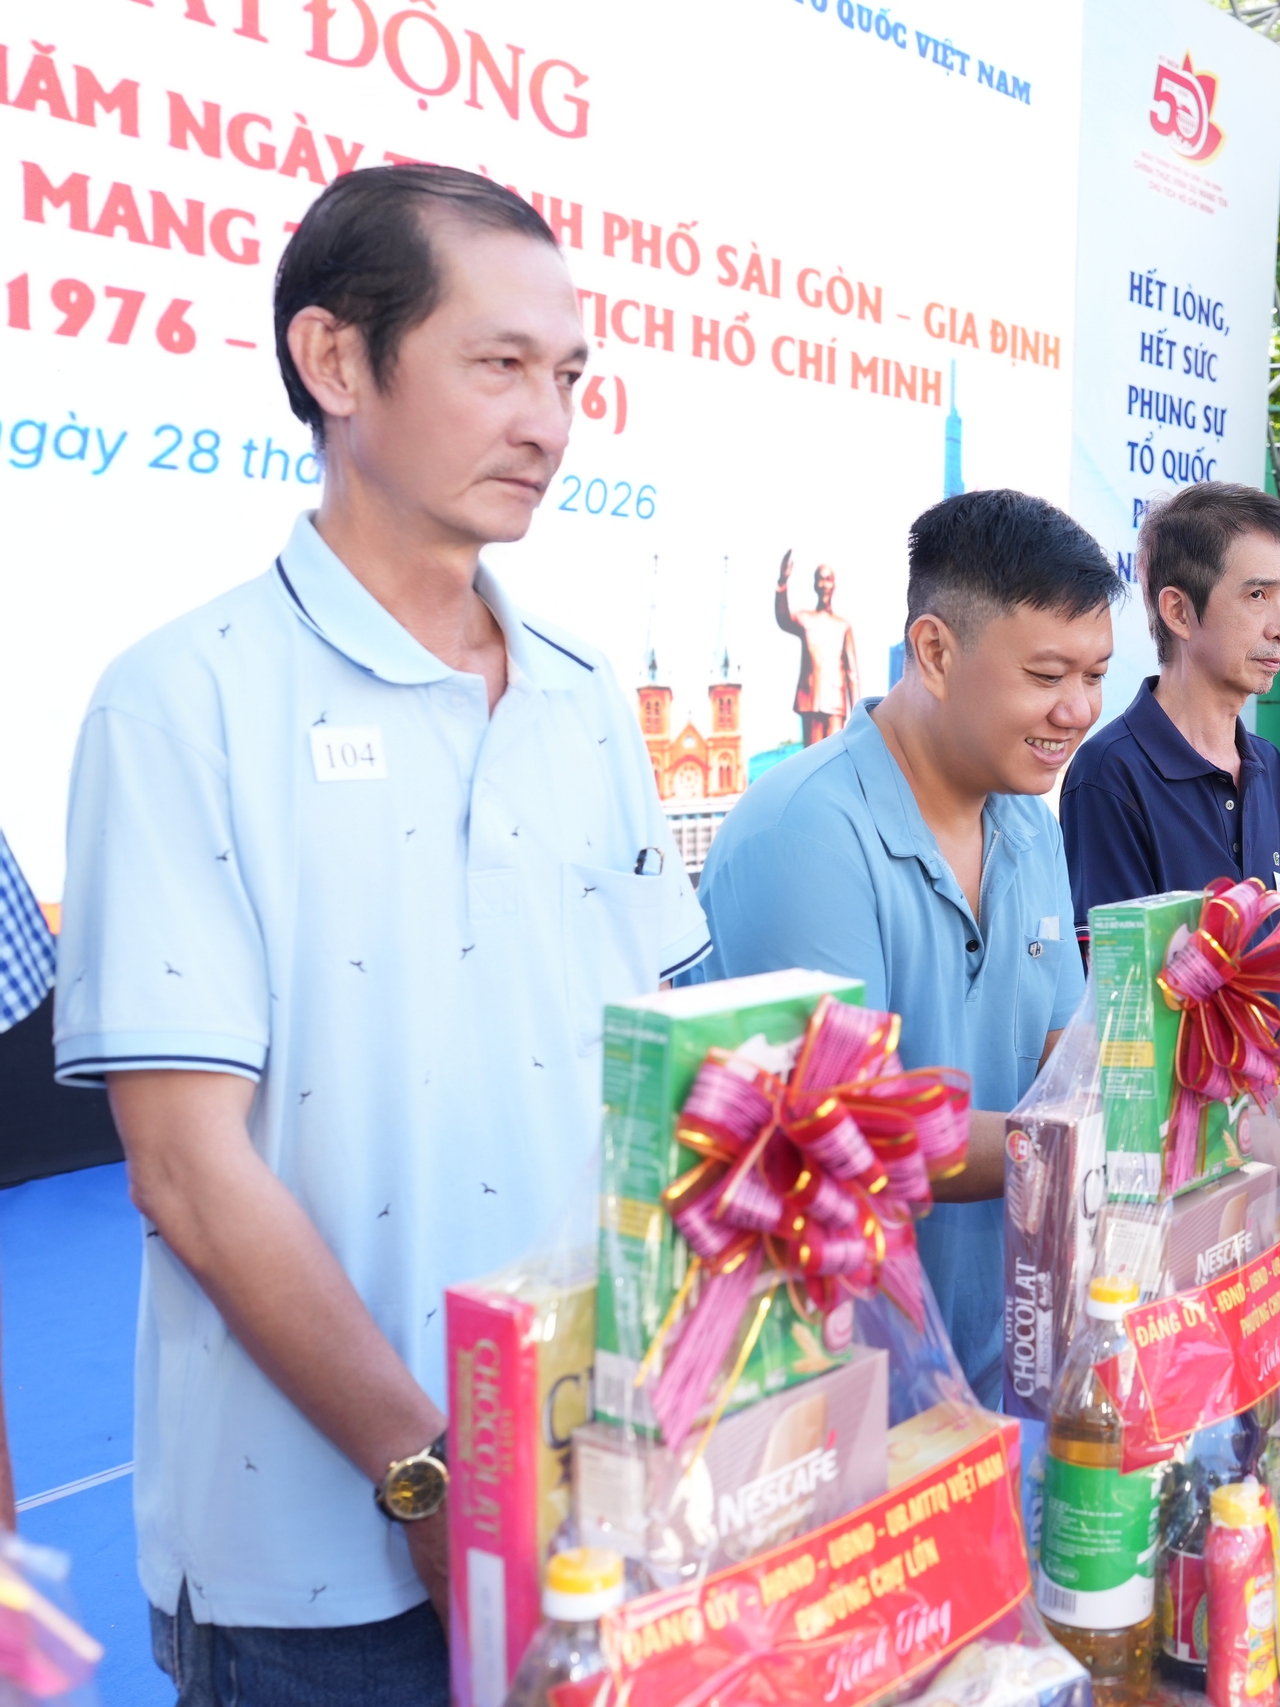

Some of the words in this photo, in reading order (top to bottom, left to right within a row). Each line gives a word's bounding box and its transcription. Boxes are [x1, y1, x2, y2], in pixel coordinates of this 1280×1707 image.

[837, 0, 907, 49] QUỐC
[915, 30, 970, 77] VIỆT
[977, 59, 1031, 105] NAM
[20, 160, 260, 266] MANG
[6, 272, 197, 354] 1976
[602, 211, 700, 276] PHỐ
[716, 240, 781, 299] SÀI
[797, 265, 882, 324] GÒN
[924, 301, 980, 350] GIA
[990, 318, 1060, 370] ĐỊNH
[1129, 268, 1167, 311] HẾT
[1173, 283, 1229, 336] LÒNG,
[692, 311, 755, 366] HỒ
[771, 337, 836, 385] CHÍ
[851, 350, 942, 407] MINH
[1140, 327, 1177, 370] HẾT
[1183, 342, 1218, 382] SỨC
[0, 411, 127, 475] gày
[148, 424, 220, 474] 28
[1128, 384, 1196, 429] PHỤNG
[1203, 405, 1227, 443] SỰ
[1127, 431, 1155, 475] TỔ
[1162, 447, 1217, 485] QUỐC
[558, 474, 657, 520] 2026
[325, 742, 376, 769] 104
[1013, 1256, 1037, 1398] CHOCOLAT
